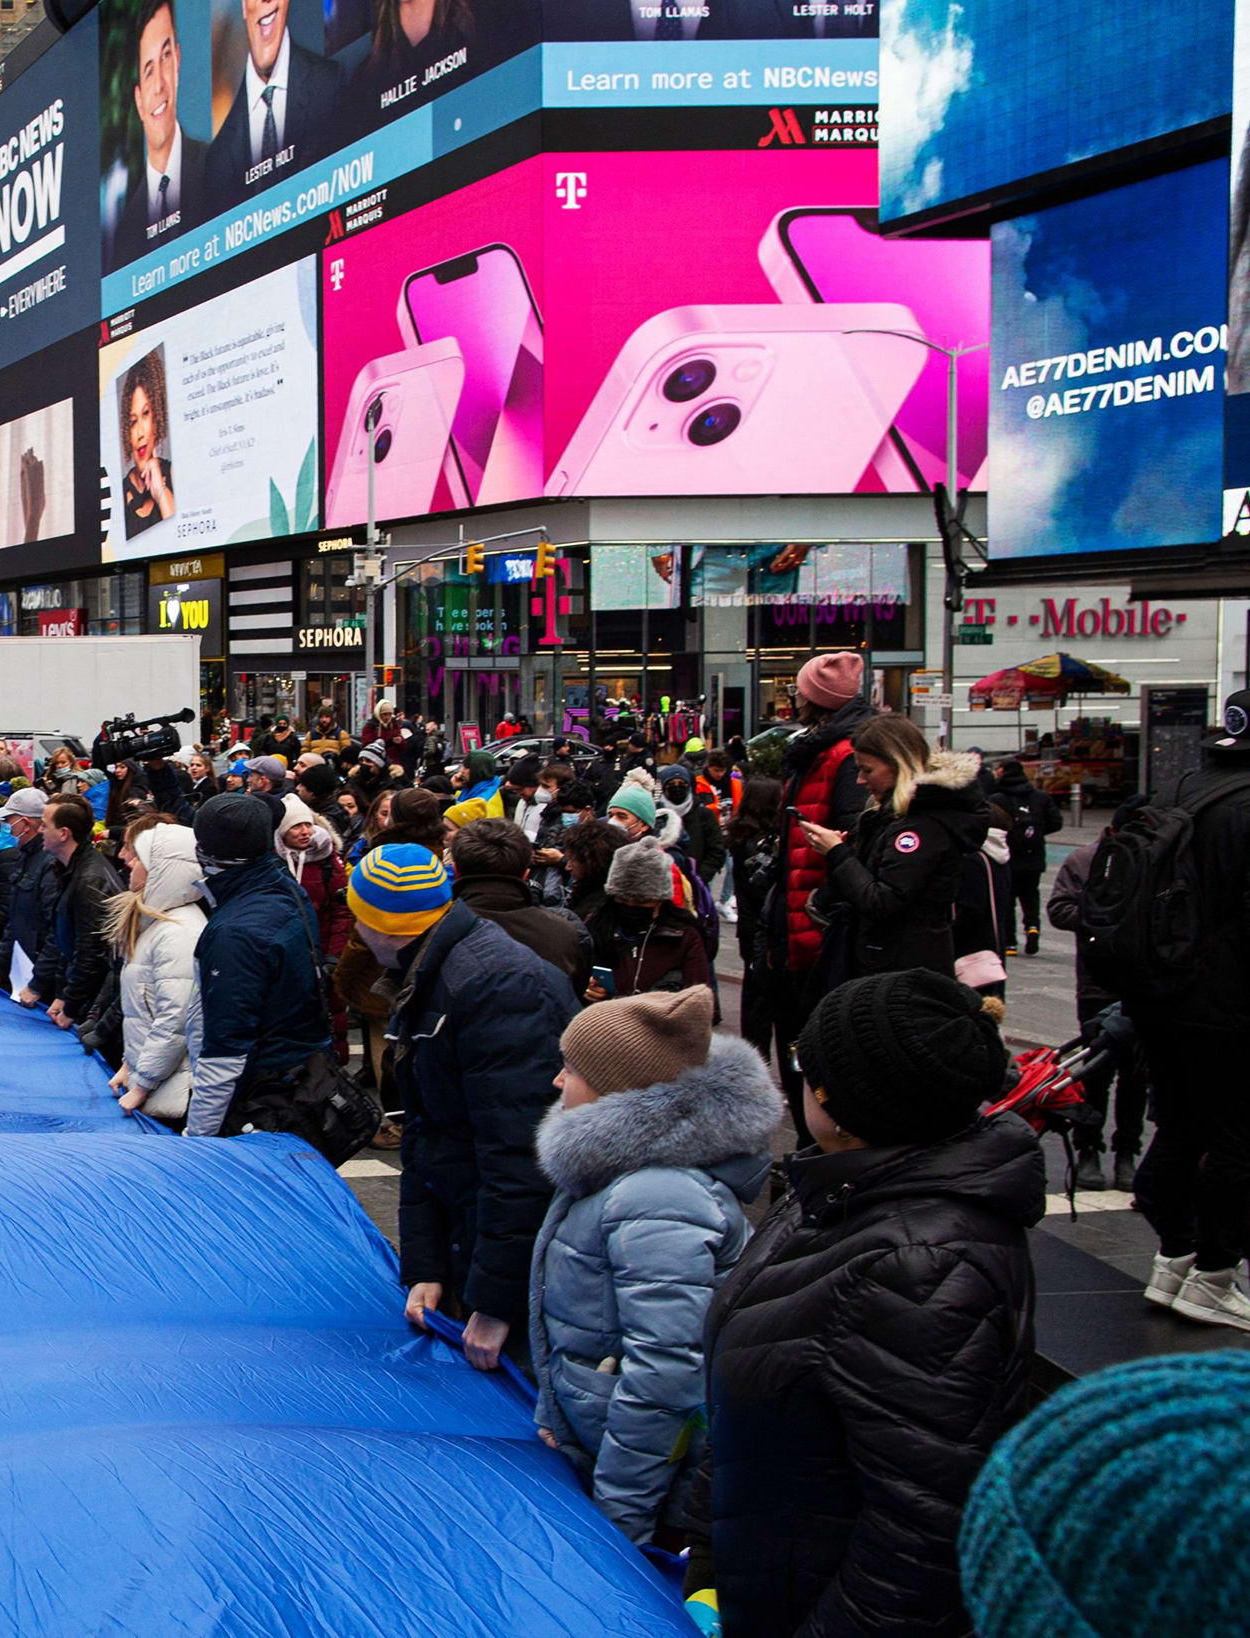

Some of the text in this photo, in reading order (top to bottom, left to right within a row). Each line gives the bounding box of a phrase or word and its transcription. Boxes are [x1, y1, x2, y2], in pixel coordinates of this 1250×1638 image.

[639, 6, 710, 18] TOM LLAMAS
[793, 4, 874, 16] LESTER HOLT
[380, 47, 468, 110] HALLIE JACKSON
[567, 70, 639, 91] Learn
[652, 70, 713, 90] more
[723, 69, 752, 88] at
[19, 98, 64, 163] NEWS
[245, 144, 296, 185] LESTER HOLT
[346, 189, 388, 217] MARRIOTT
[132, 151, 375, 297] Learn more at NBCNews.com/NOW
[346, 206, 383, 232] MARQUIS
[8, 265, 67, 319] EVERYWHERE
[1002, 324, 1229, 391] AE77DENIM.CO
[1026, 365, 1215, 419] @AE77DENIM
[177, 519, 217, 538] SEPHORA
[318, 537, 353, 552] SEPHORA
[180, 600, 209, 630] YOU
[299, 627, 363, 648] SEPHORA
